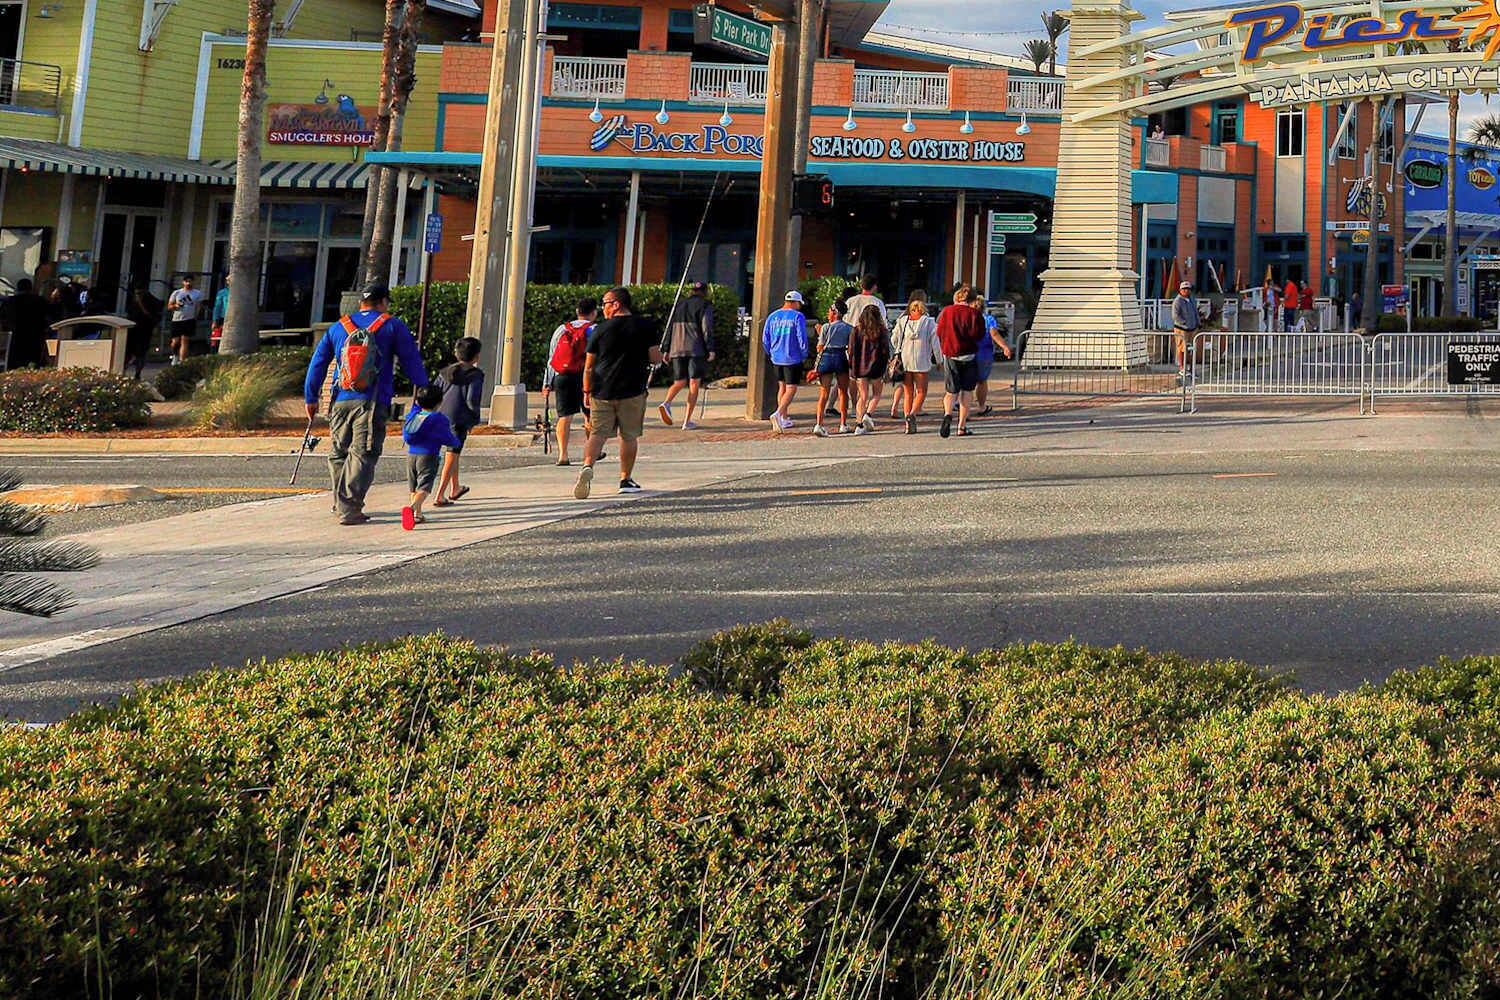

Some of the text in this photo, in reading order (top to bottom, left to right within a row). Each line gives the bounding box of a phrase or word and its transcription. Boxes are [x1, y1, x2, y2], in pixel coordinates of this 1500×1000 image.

[715, 16, 769, 49] S Pier Park Dr
[1225, 3, 1463, 64] Pier
[1261, 71, 1393, 105] PANAMA
[1407, 66, 1481, 87] CITY
[270, 131, 341, 143] SMUGGLER'S
[701, 125, 764, 158] PORC
[811, 136, 1024, 161] SEAFOOD & OYSTER HOUSE
[822, 183, 831, 204] 6
[1458, 354, 1499, 362] TRAFFIC
[1465, 363, 1491, 371] ONLY
